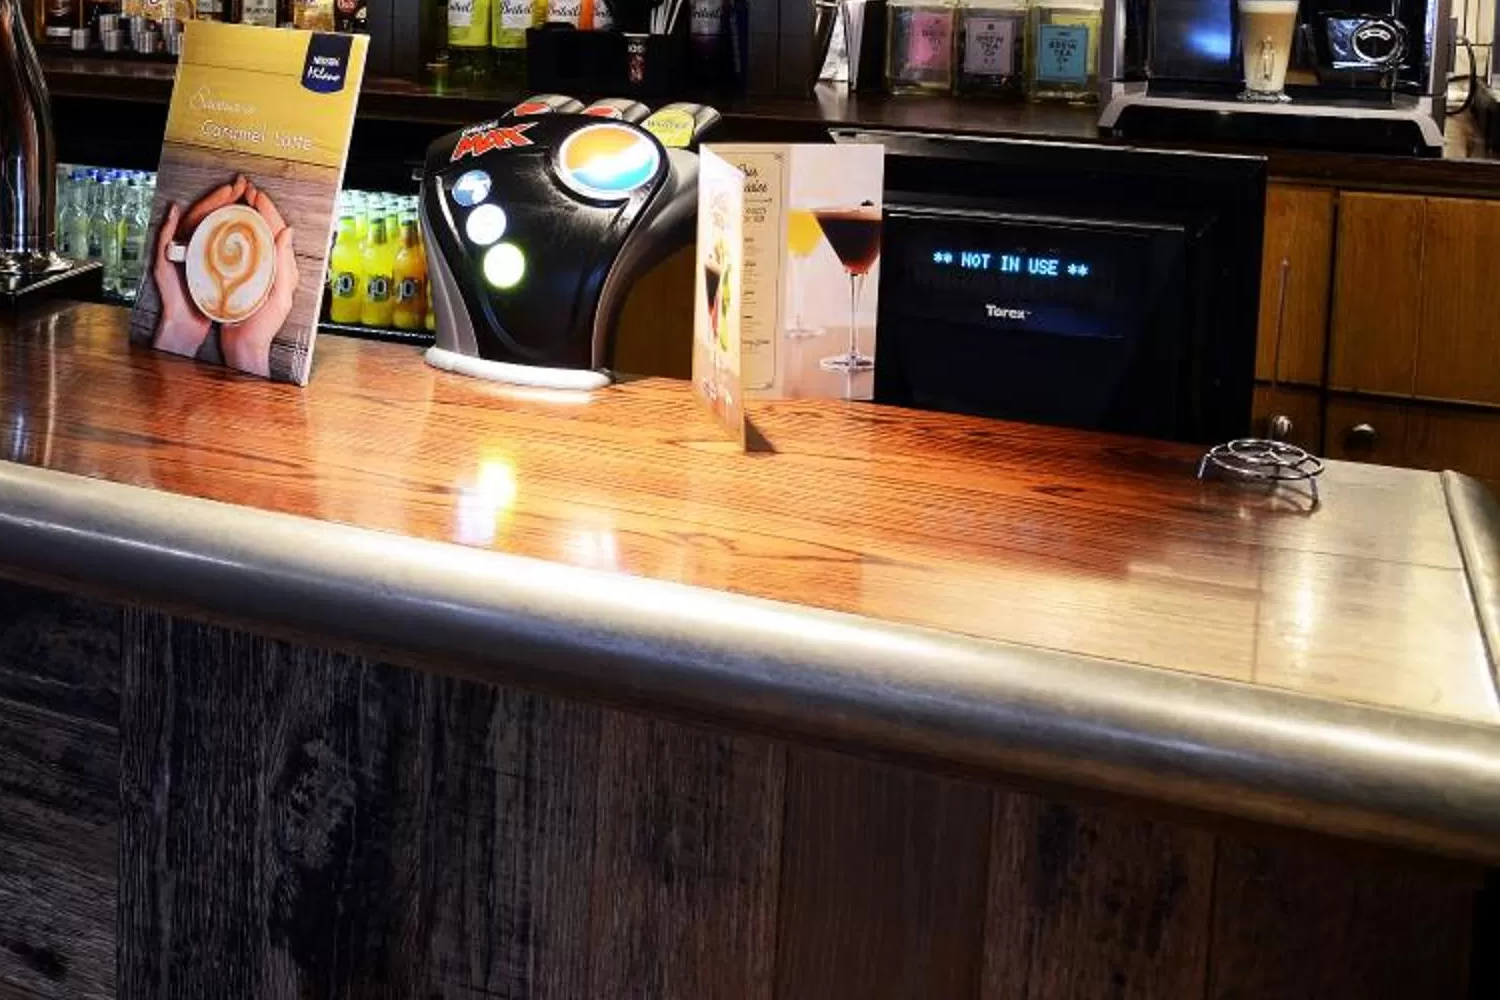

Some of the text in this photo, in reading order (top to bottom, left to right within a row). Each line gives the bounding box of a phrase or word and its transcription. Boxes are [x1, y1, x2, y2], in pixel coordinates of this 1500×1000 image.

[199, 119, 266, 143] Caramel
[450, 121, 540, 163] MAX
[960, 252, 1060, 276] NOT IN USE
[986, 304, 1026, 320] Torex
